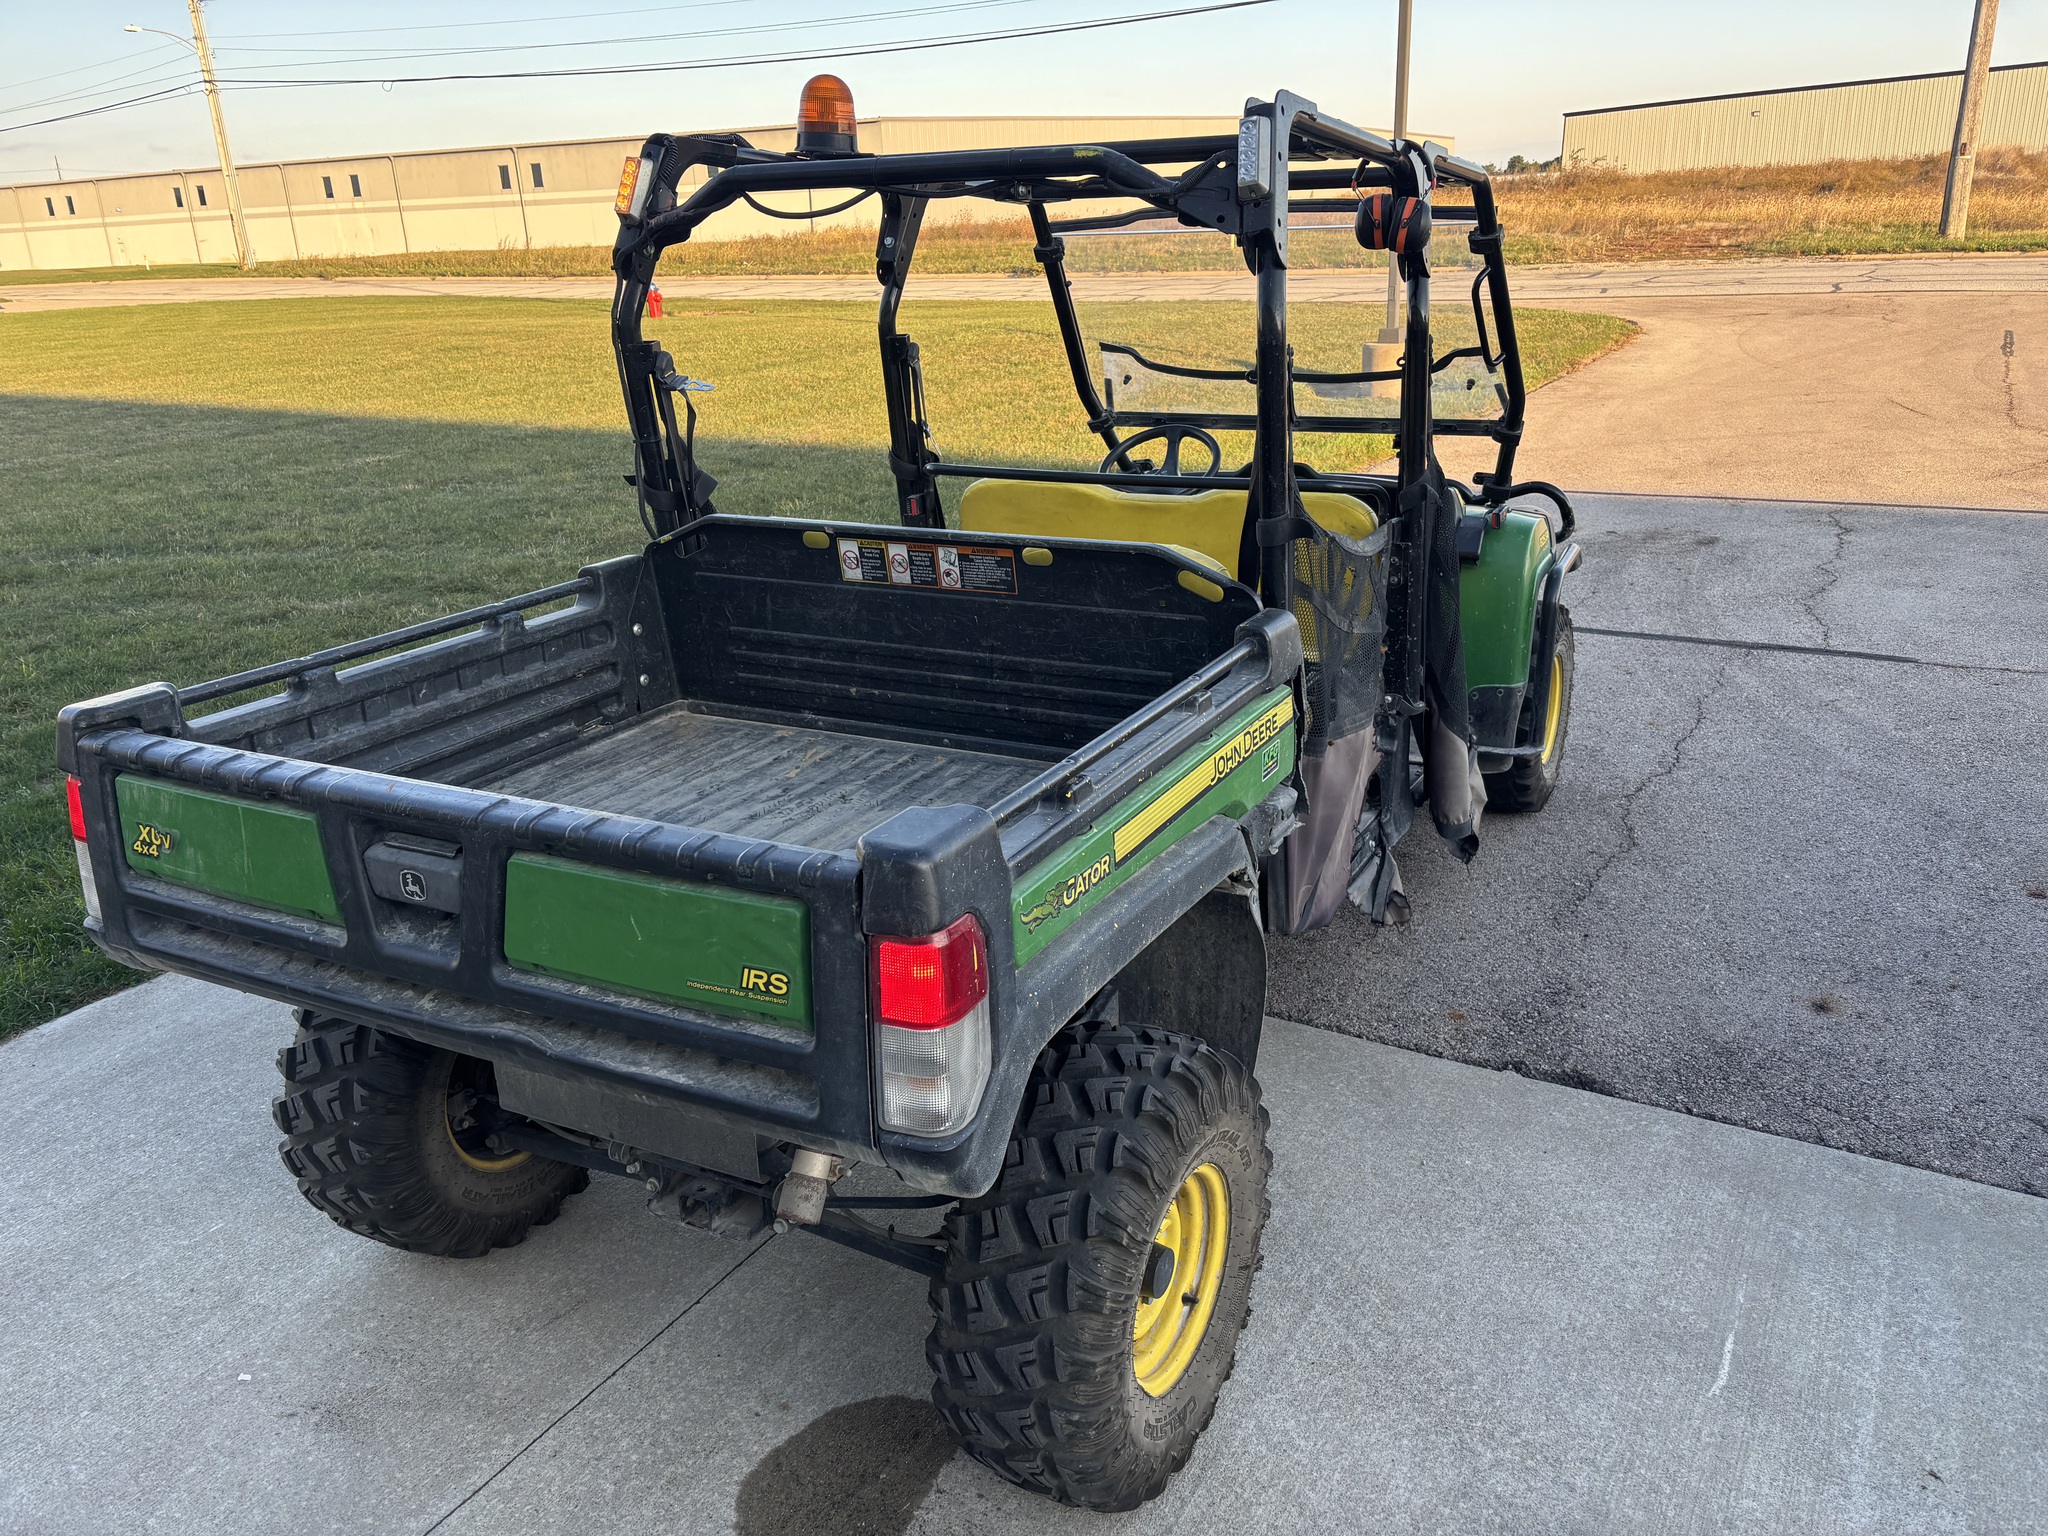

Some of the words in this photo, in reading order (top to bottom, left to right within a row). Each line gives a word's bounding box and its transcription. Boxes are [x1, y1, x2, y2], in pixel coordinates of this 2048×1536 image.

[1211, 742, 1242, 783] JOHN
[1243, 713, 1278, 755] DEERE
[133, 840, 159, 857] 4x4
[138, 824, 171, 849] XUV
[1063, 854, 1111, 906] GATOR
[686, 980, 728, 994] Independent
[729, 988, 746, 997] Rear
[748, 992, 788, 1005] Suspension
[741, 967, 789, 996] IRS
